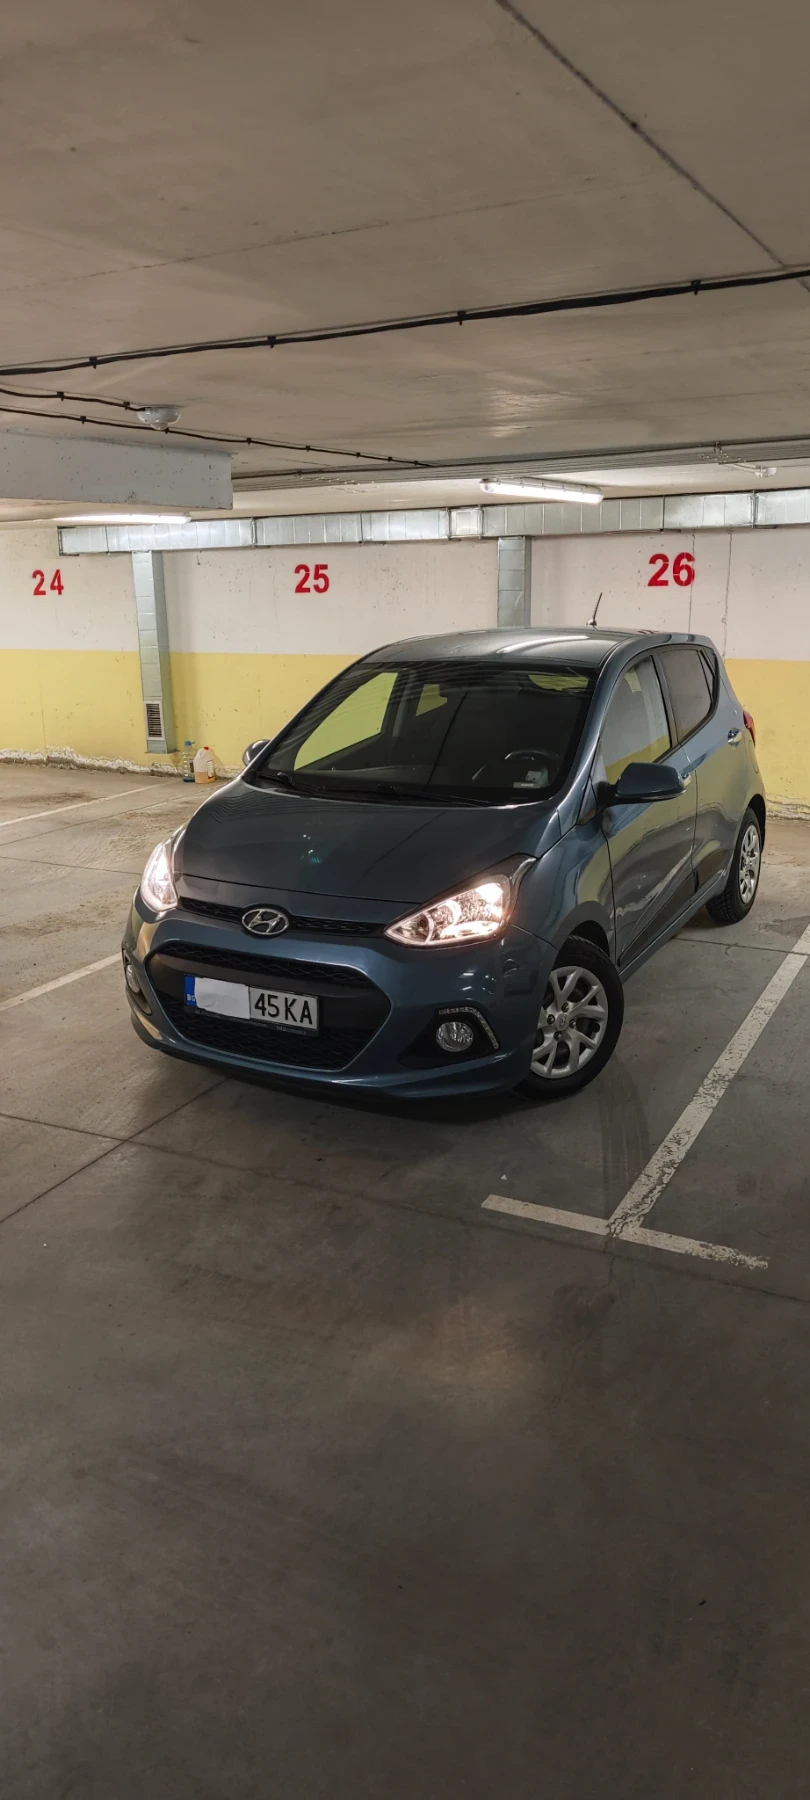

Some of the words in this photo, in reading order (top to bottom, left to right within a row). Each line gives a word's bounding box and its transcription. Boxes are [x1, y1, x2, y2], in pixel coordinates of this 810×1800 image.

[32, 569, 64, 596] 24
[294, 564, 330, 593] 25
[648, 552, 695, 587] 26
[254, 992, 280, 1018] 45
[284, 997, 313, 1025] KA
